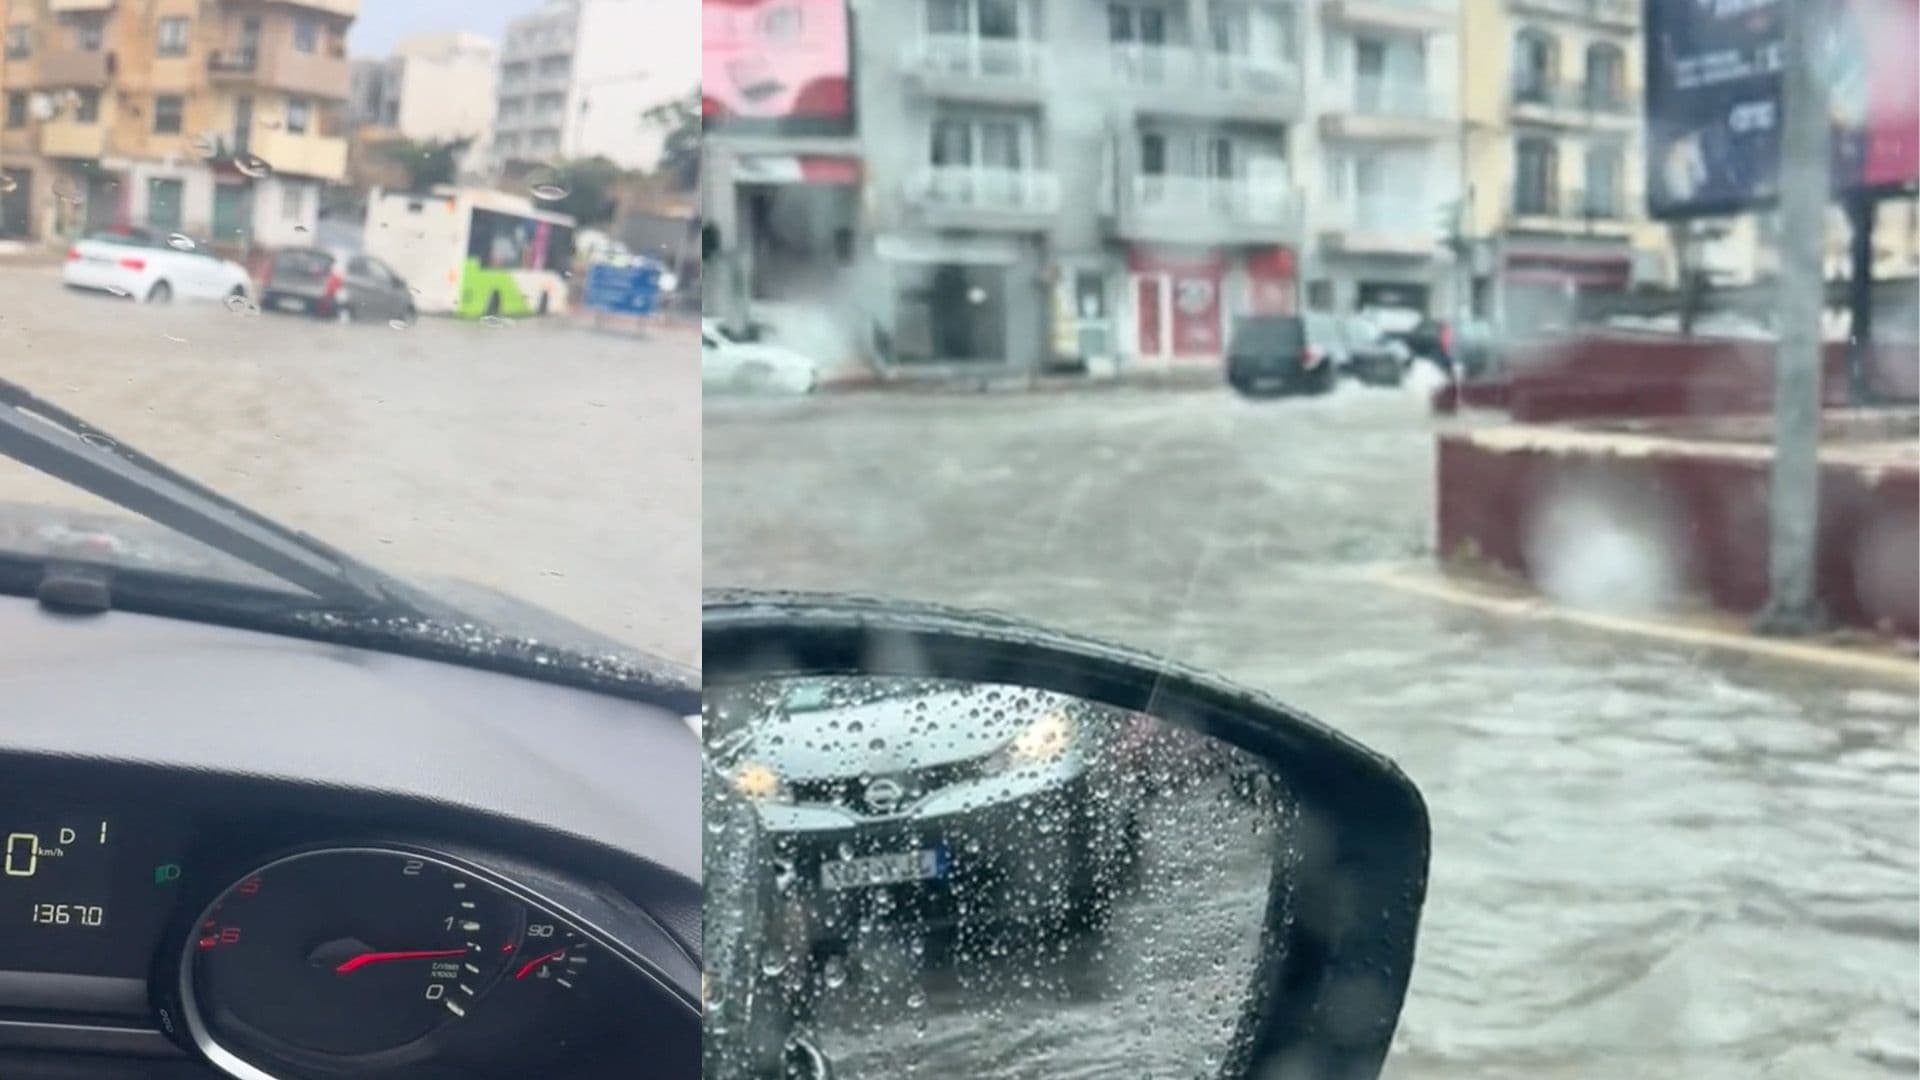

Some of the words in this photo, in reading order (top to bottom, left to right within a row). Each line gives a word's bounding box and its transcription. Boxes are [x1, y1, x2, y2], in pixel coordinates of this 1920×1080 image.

[60, 827, 75, 844] D
[100, 821, 106, 844] 1
[6, 833, 38, 876] 0
[38, 847, 64, 857] km/h
[403, 860, 424, 875] 2
[444, 916, 454, 931] 1
[527, 924, 553, 937] 90
[221, 927, 240, 943] 6
[426, 984, 443, 999] 0
